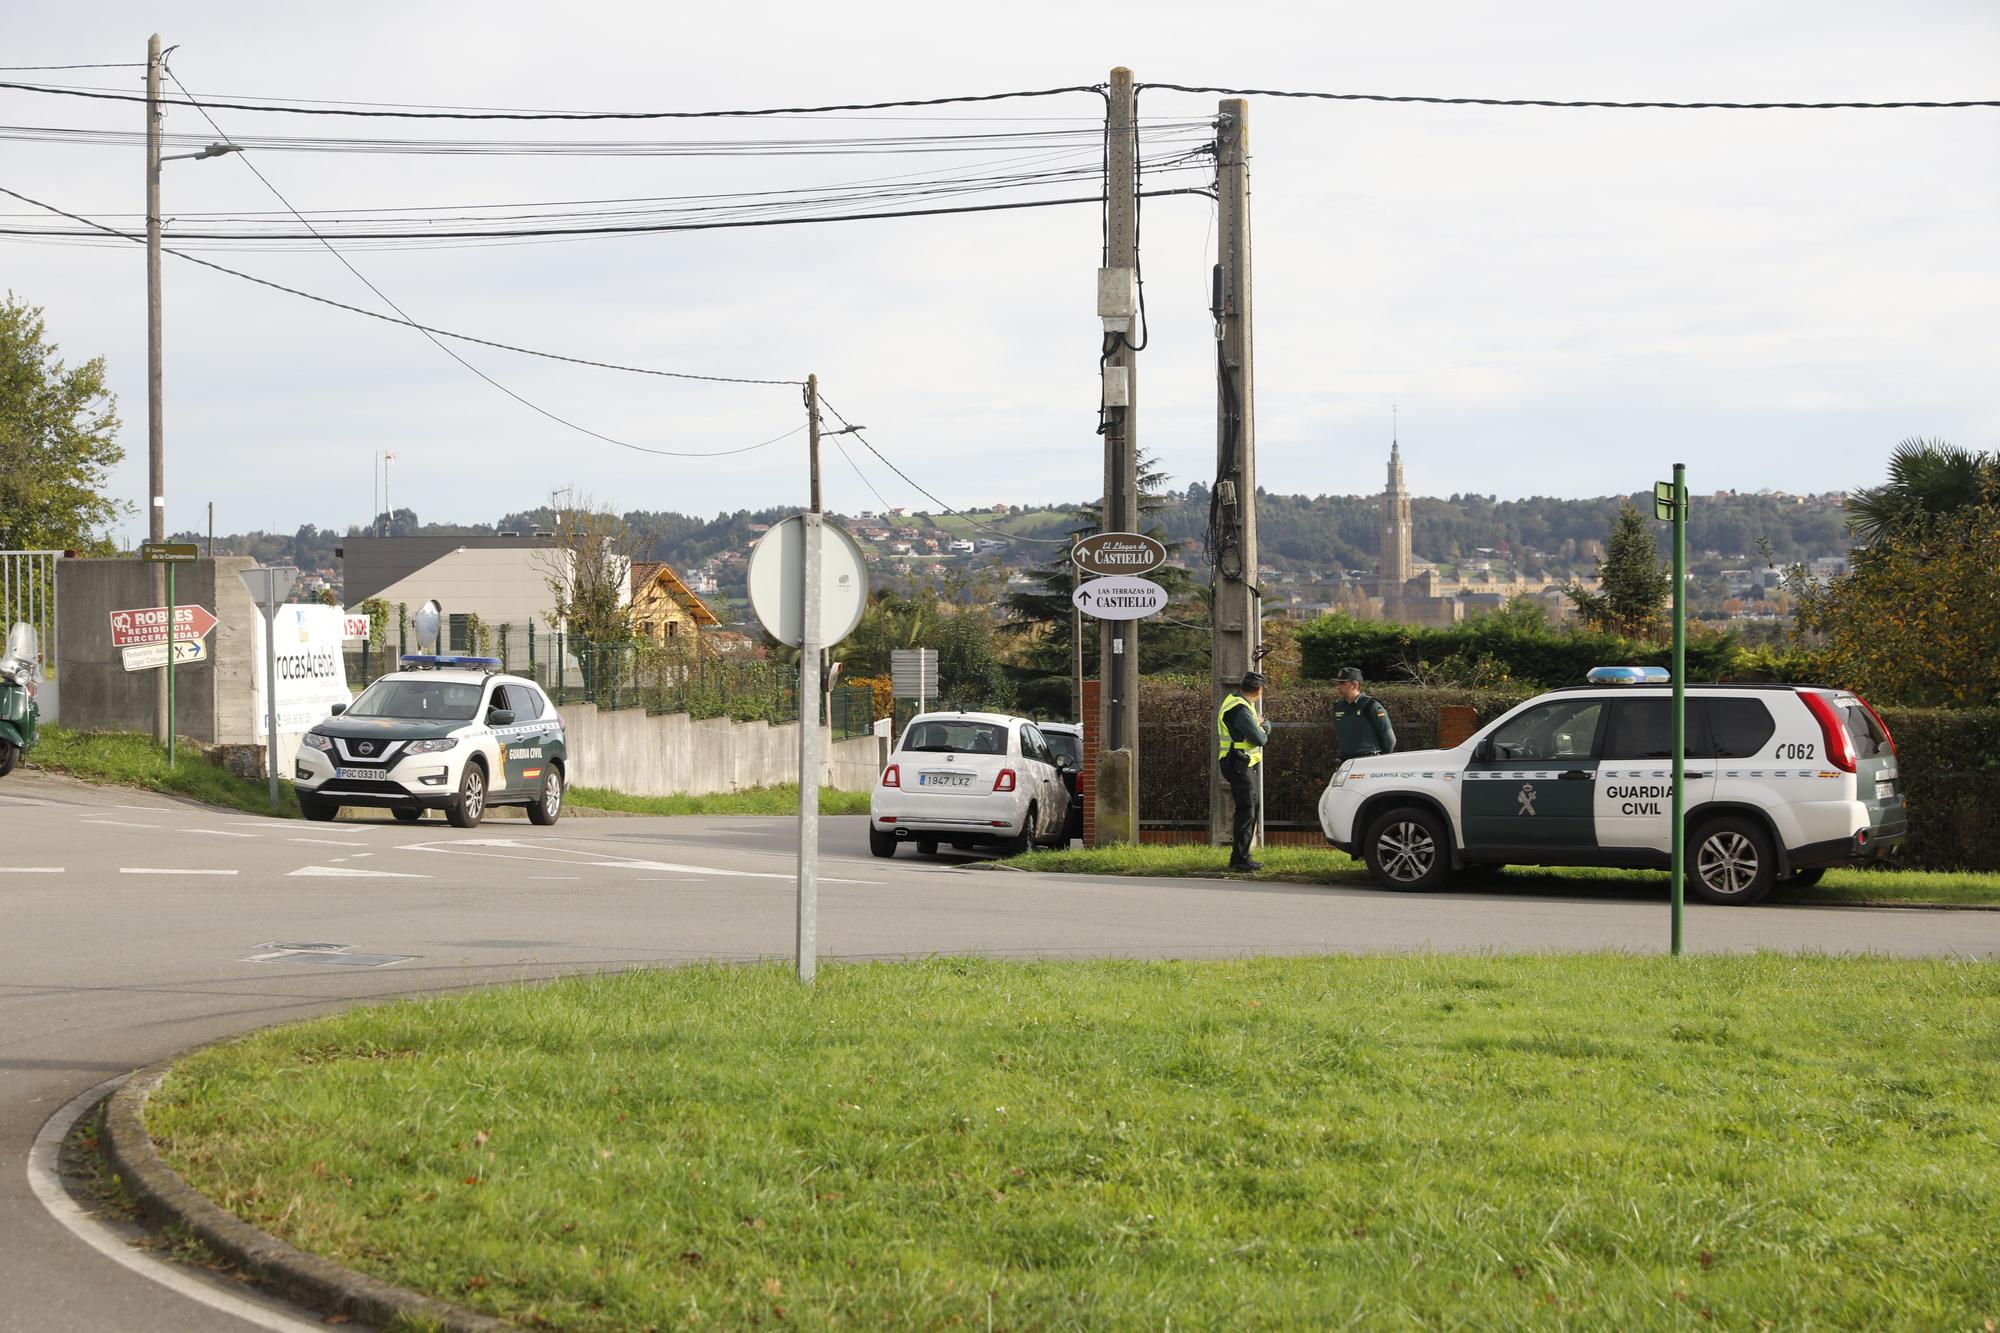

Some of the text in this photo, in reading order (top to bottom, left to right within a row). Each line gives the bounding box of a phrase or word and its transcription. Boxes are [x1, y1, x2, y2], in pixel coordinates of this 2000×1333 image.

[1102, 542, 1111, 550] El
[1138, 542, 1147, 550] de
[1096, 596, 1156, 608] CASTIELLO
[135, 609, 194, 624] ROBES
[128, 624, 191, 636] RESIDECIA
[509, 747, 543, 760] GUARDIA CIVIL
[1787, 743, 1815, 760] 062
[341, 769, 357, 778] PGC
[927, 776, 970, 786] 1947 LXZ
[1606, 785, 1673, 799] GUARDIA
[1621, 802, 1662, 815] CIVIL
